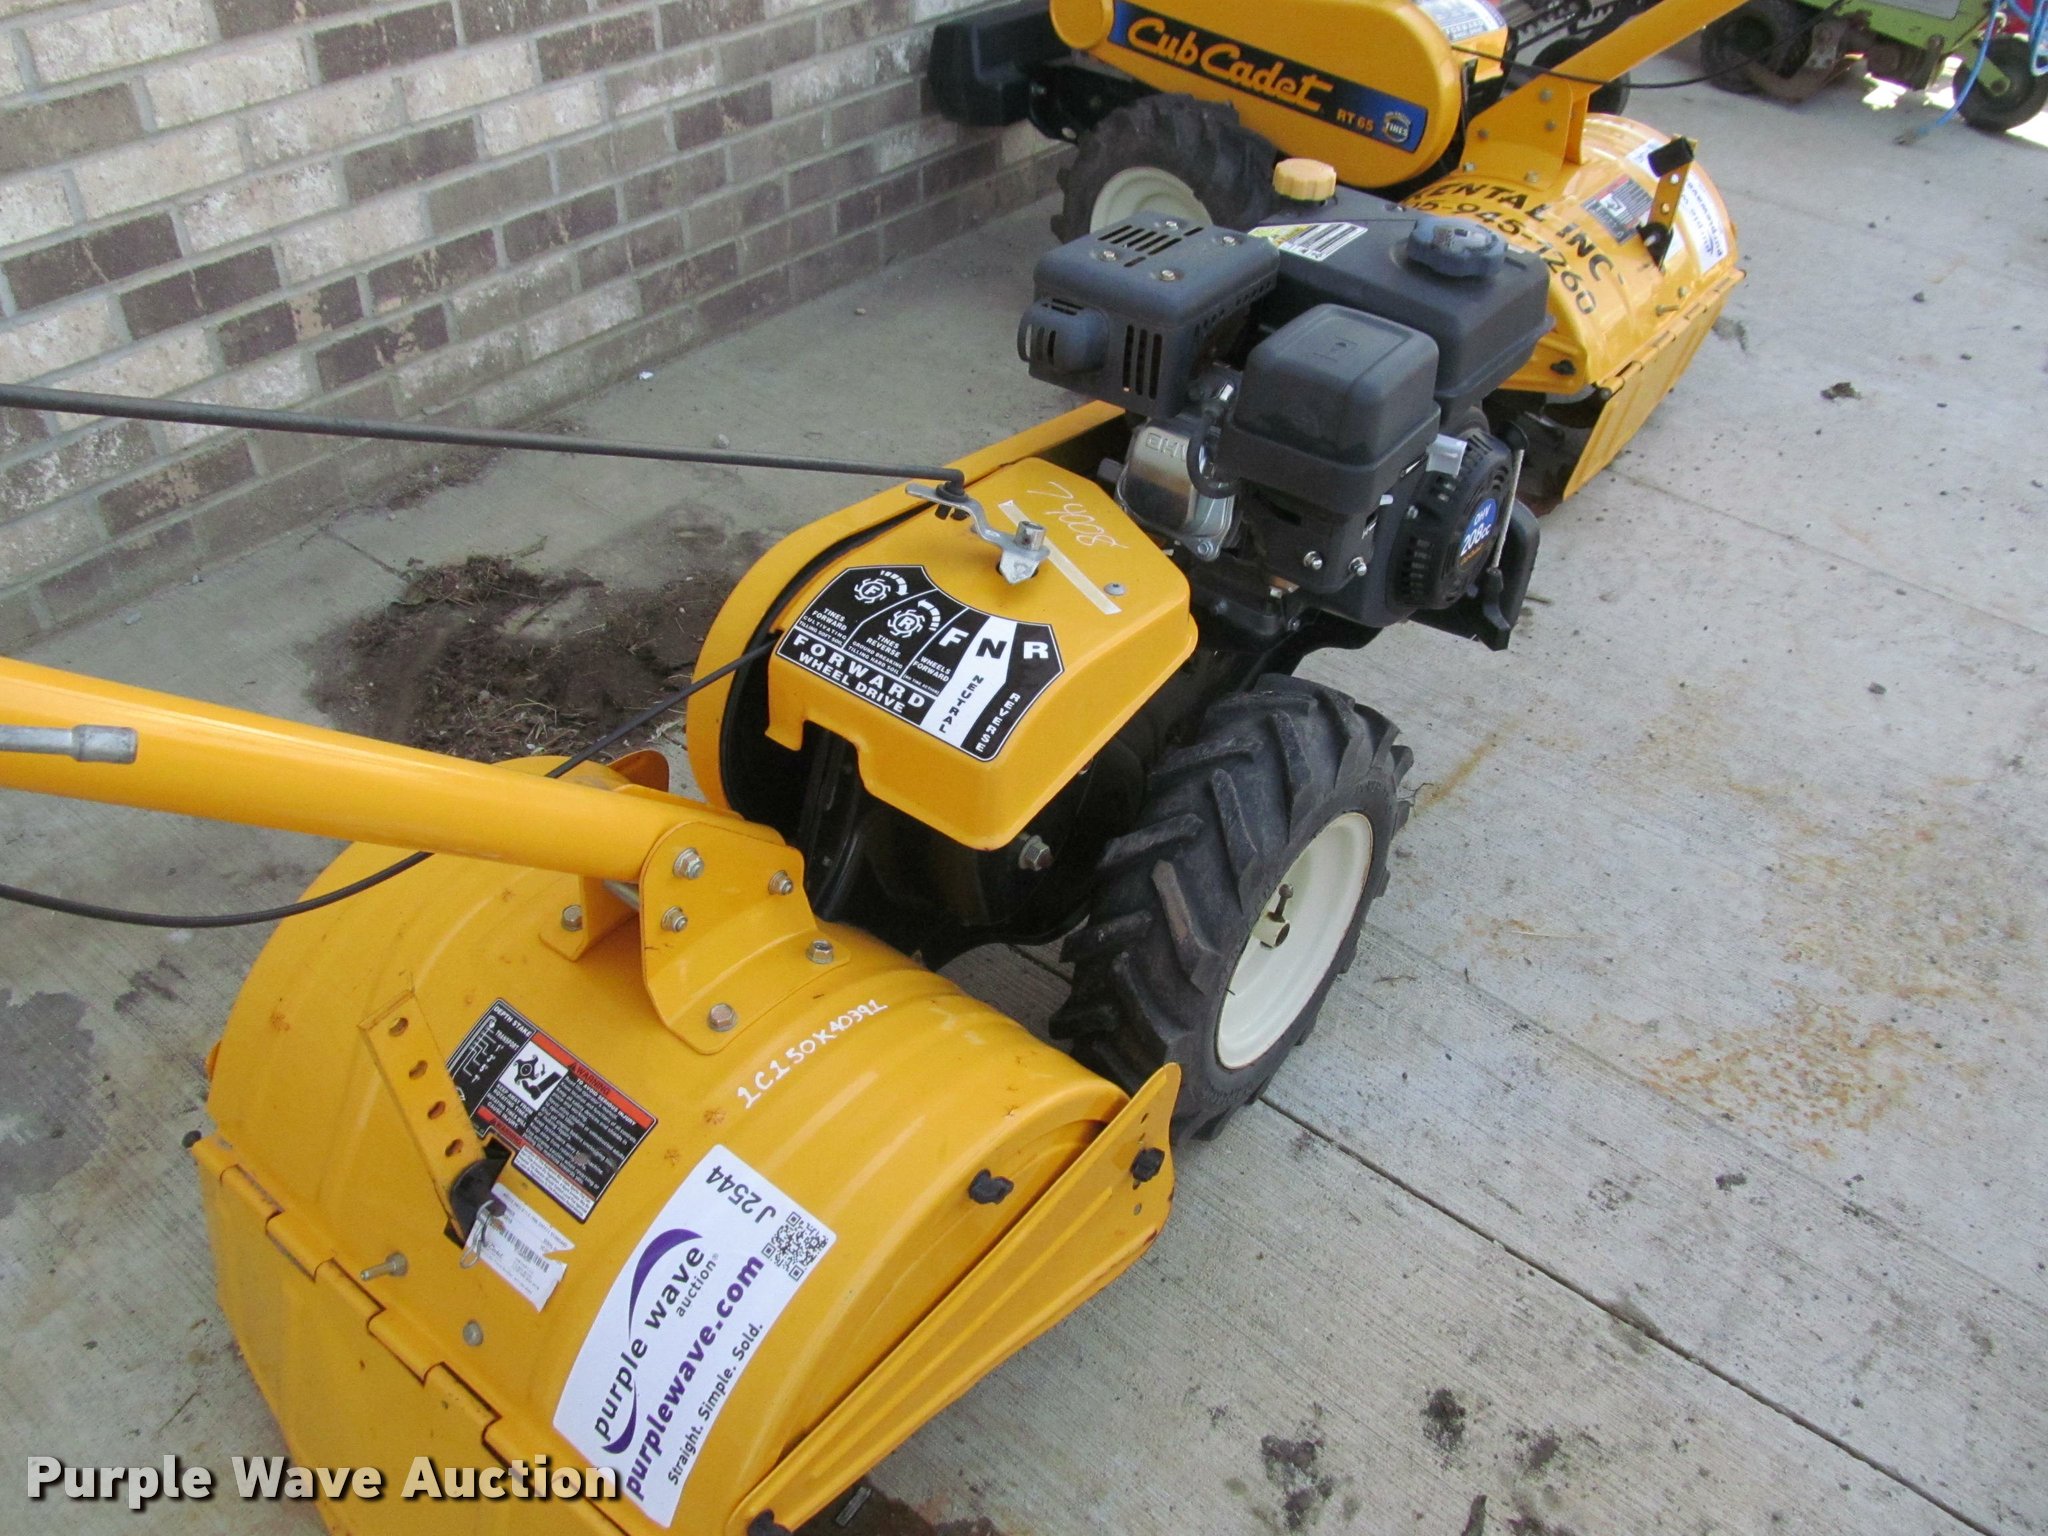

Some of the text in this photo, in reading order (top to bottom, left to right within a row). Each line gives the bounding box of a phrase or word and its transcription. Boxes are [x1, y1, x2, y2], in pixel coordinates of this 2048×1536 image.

[1127, 16, 1334, 111] Cub Cadet
[1336, 108, 1355, 124] RT
[1356, 116, 1374, 132] 65
[797, 620, 819, 633] TILLING
[800, 615, 849, 640] CULTIVATING
[809, 610, 849, 631] FORWARD
[821, 607, 847, 622] TINES
[864, 637, 902, 658] REVERSE
[875, 634, 901, 649] TINES
[937, 625, 969, 652] F
[975, 637, 1007, 661] N
[1022, 641, 1050, 660] R
[846, 645, 900, 675] TILLING HARD SOIL
[850, 641, 904, 669] GROUND BREAKING
[918, 655, 952, 675] WHEELS
[791, 633, 927, 710] FORWARD
[796, 651, 907, 713] WHEEL DRIVE
[911, 660, 951, 682] FORWARD
[939, 674, 984, 734] NEUTRAL
[976, 692, 1021, 752] REVERSE
[493, 1005, 532, 1037] DEPTH STAKE
[494, 1029, 519, 1051] TRANSPORT
[574, 1065, 611, 1096] WARNING
[576, 1077, 636, 1126] TO AVOID SERIOUS INJURY
[706, 1165, 776, 1224] J2544
[594, 1247, 704, 1442] purple wave
[626, 1256, 765, 1501] purplewave.com
[668, 1322, 763, 1486] Straight. Simple. Sold.
